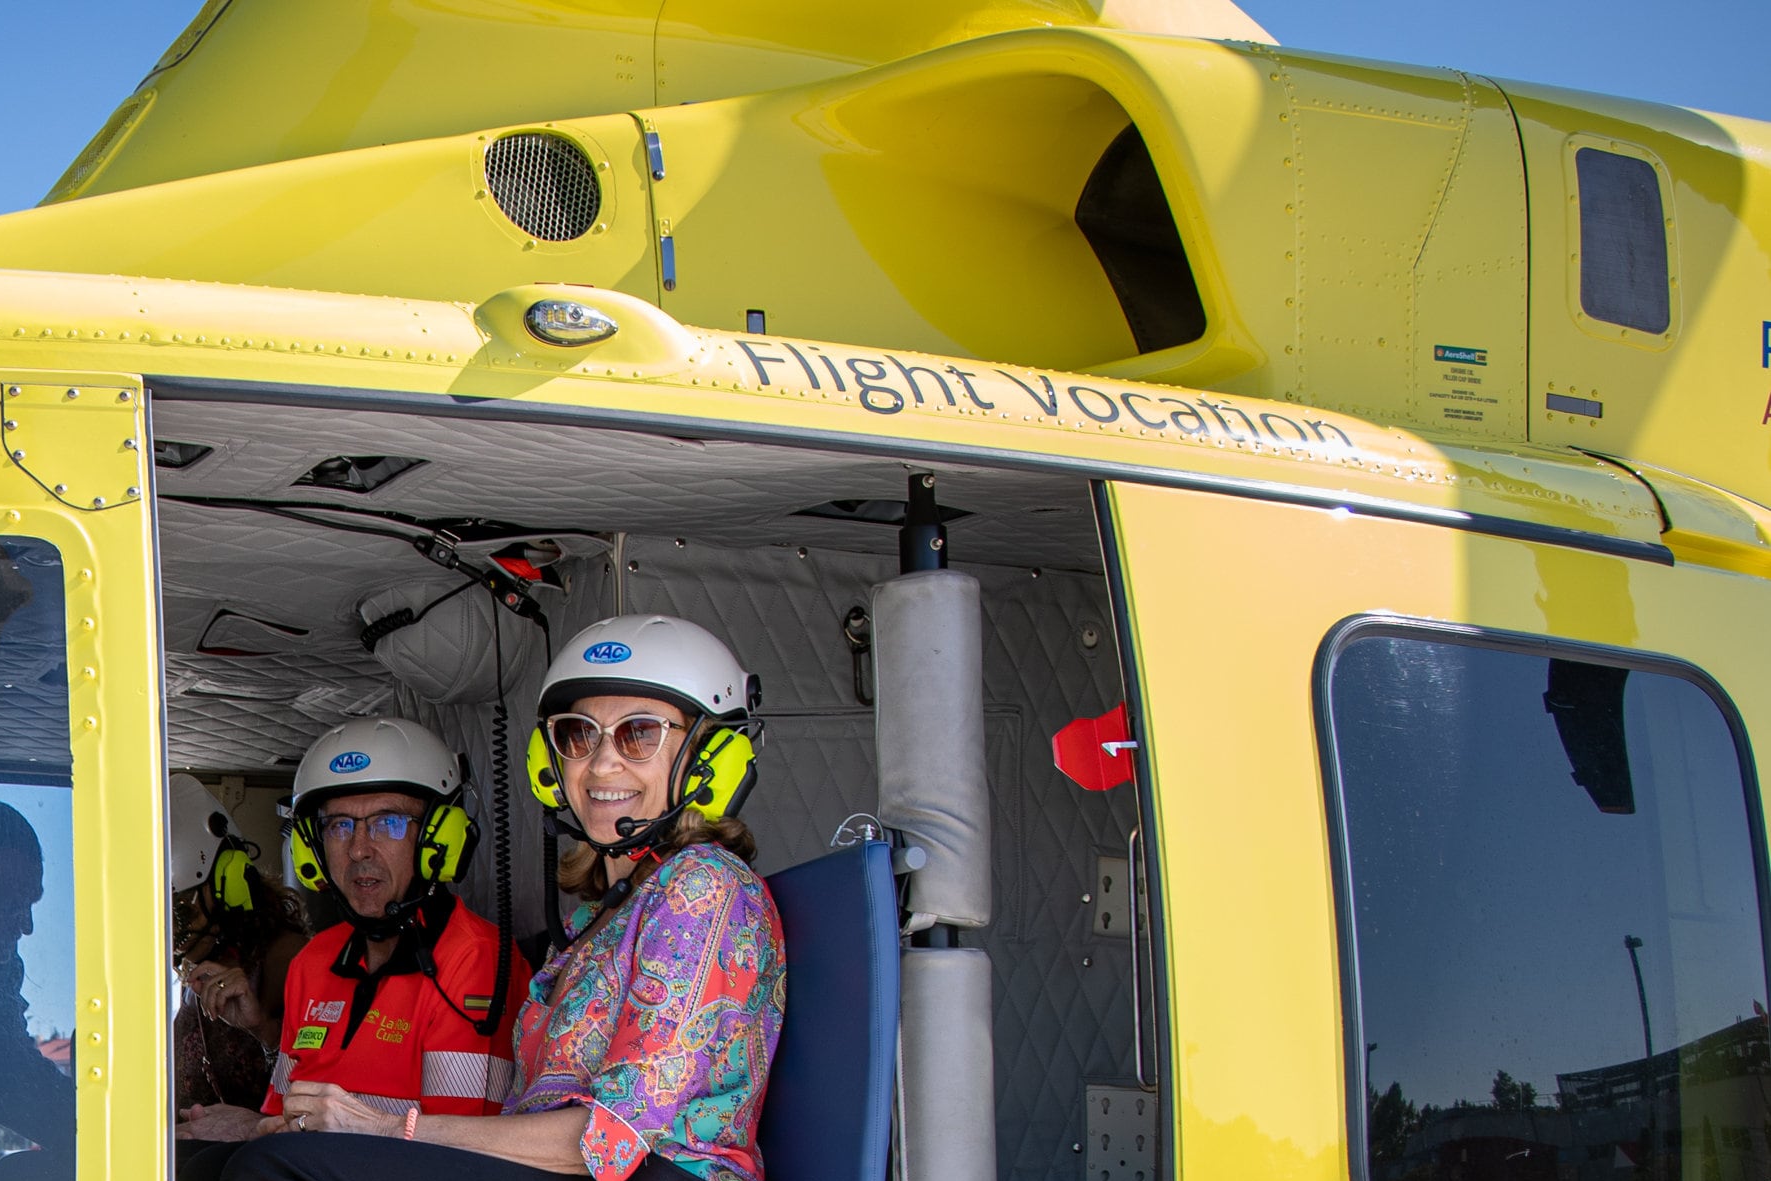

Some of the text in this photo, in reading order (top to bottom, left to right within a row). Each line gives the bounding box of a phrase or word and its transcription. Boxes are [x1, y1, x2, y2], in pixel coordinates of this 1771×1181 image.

[1443, 349, 1476, 361] AeroShell
[735, 339, 1355, 452] Flight Vocation
[590, 645, 624, 659] NAC
[335, 755, 364, 768] NAC
[380, 1015, 411, 1034] La Rioj
[375, 1028, 404, 1044] Cuida
